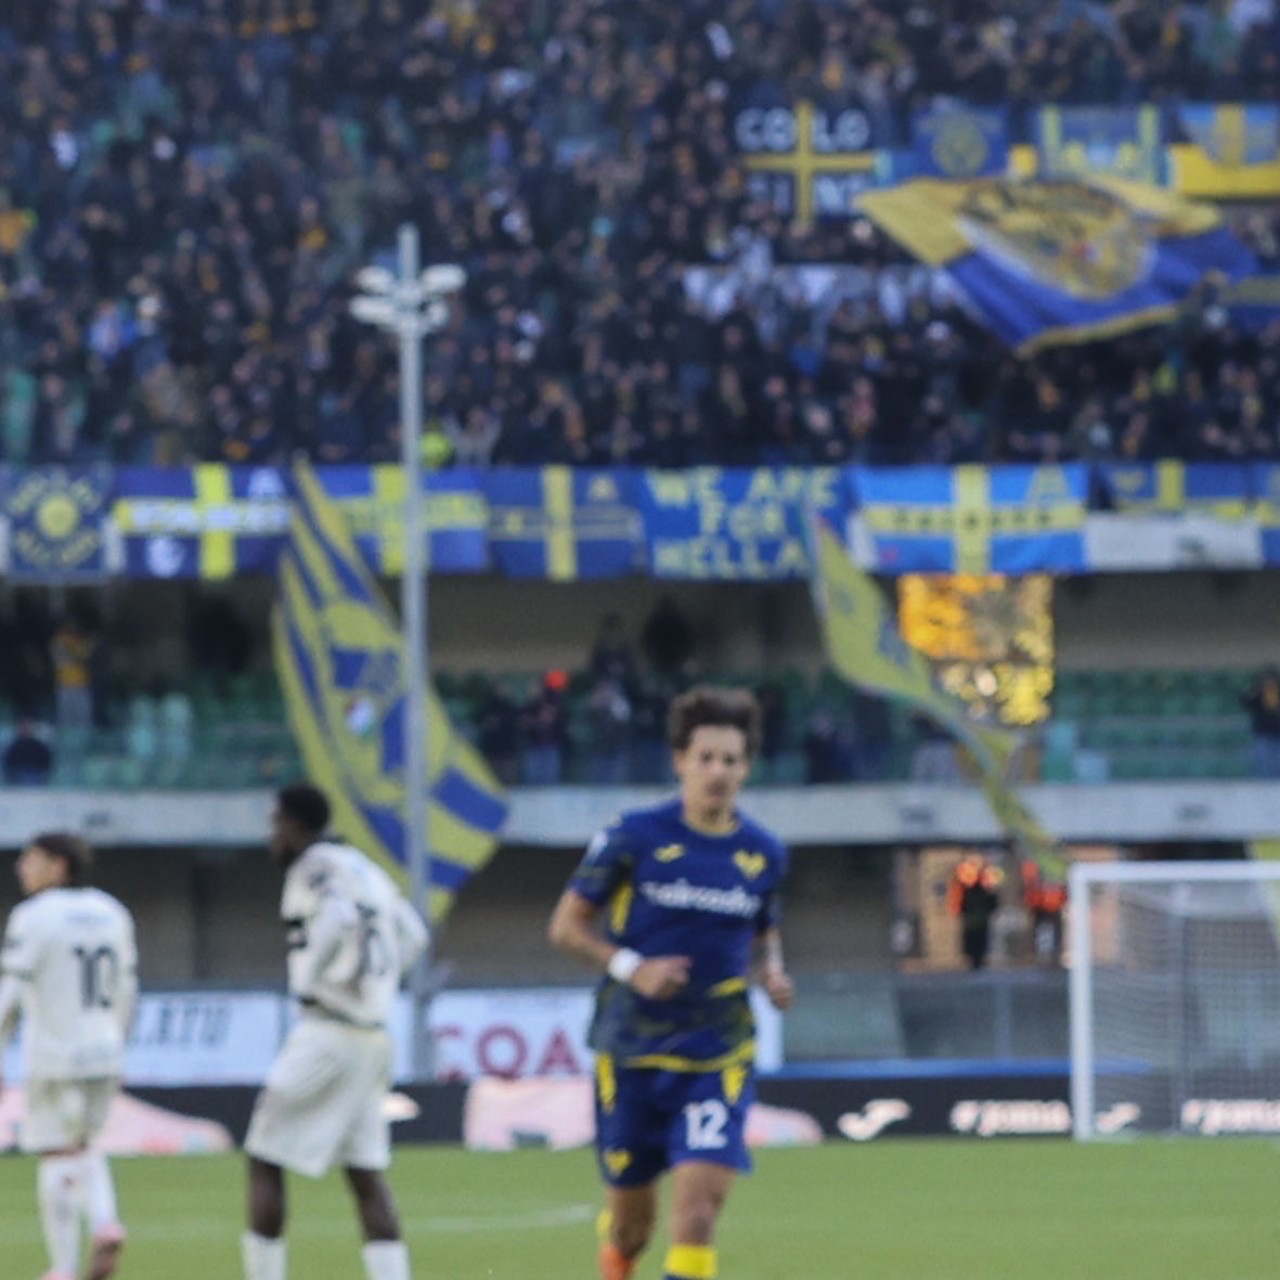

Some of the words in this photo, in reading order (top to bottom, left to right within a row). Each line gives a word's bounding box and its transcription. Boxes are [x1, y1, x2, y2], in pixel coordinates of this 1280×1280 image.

[652, 537, 810, 582] HELLA
[73, 944, 119, 1009] 10
[681, 1098, 729, 1151] 12
